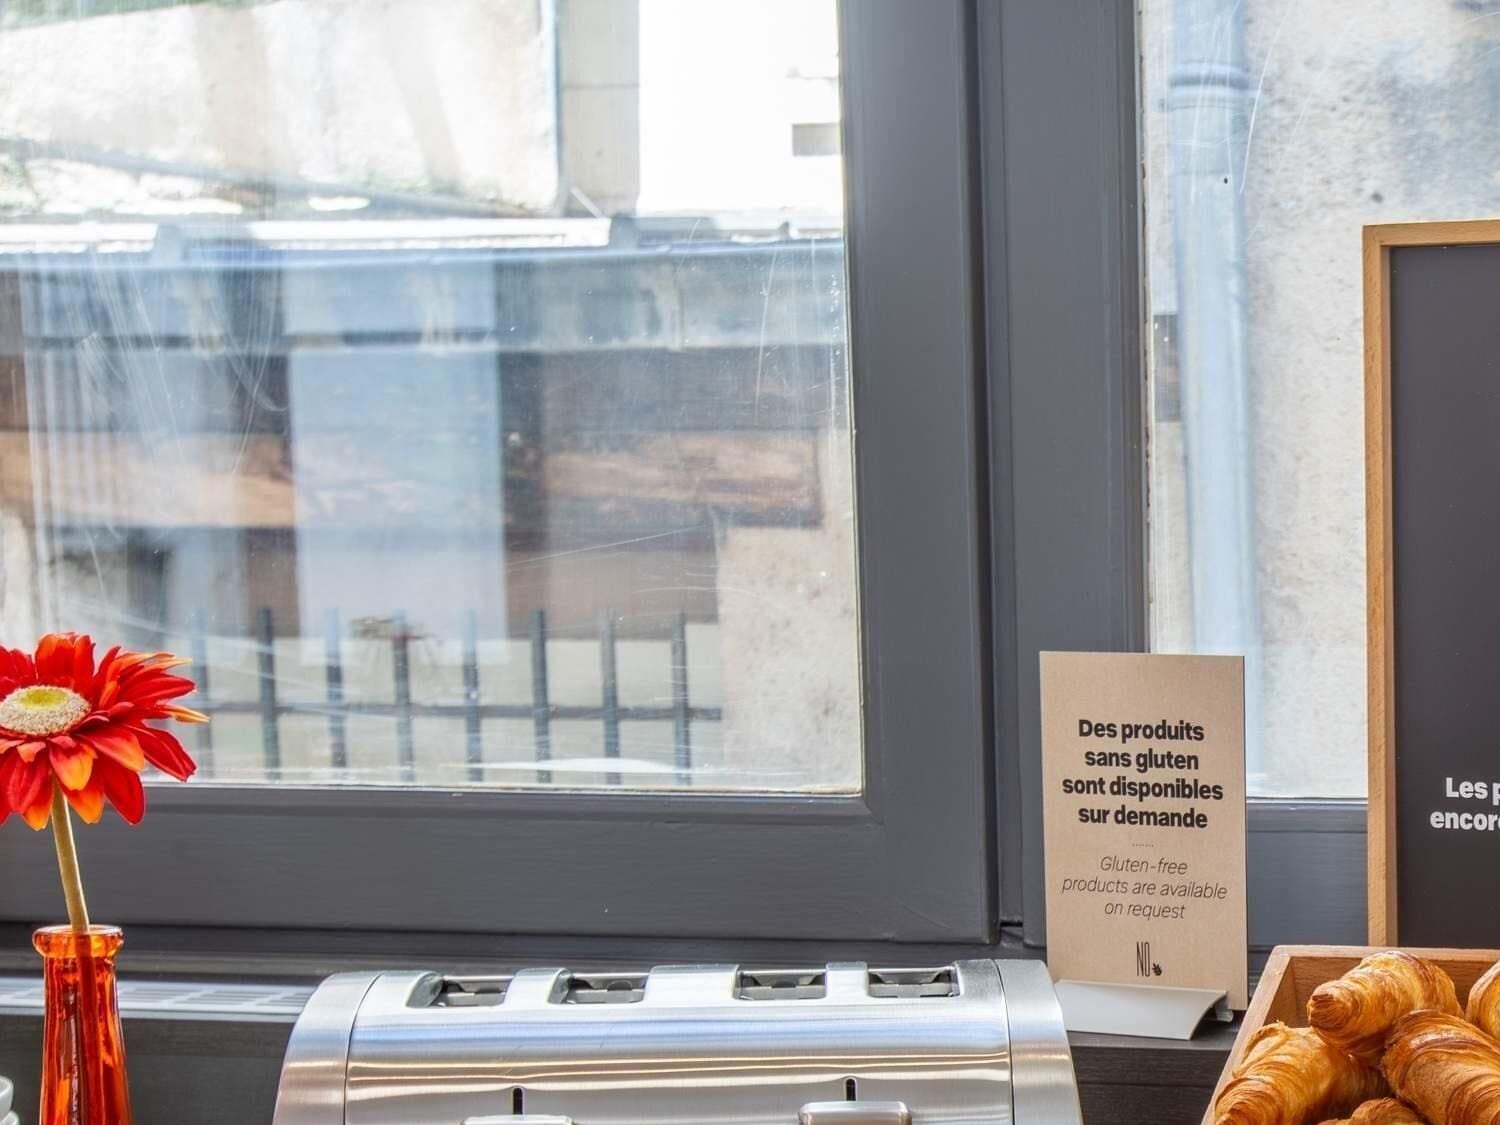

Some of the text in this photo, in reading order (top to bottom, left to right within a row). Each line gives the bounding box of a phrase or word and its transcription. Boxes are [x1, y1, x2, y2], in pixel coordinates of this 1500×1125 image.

[1078, 719, 1205, 744] Des produits
[1084, 748, 1199, 773] sans gluten
[1062, 776, 1224, 802] sont disponibles
[1446, 777, 1489, 800] Les
[1078, 804, 1208, 829] sur demande
[1100, 856, 1188, 876] Gluten-free
[1061, 876, 1228, 900] products are available
[1104, 902, 1186, 921] on request
